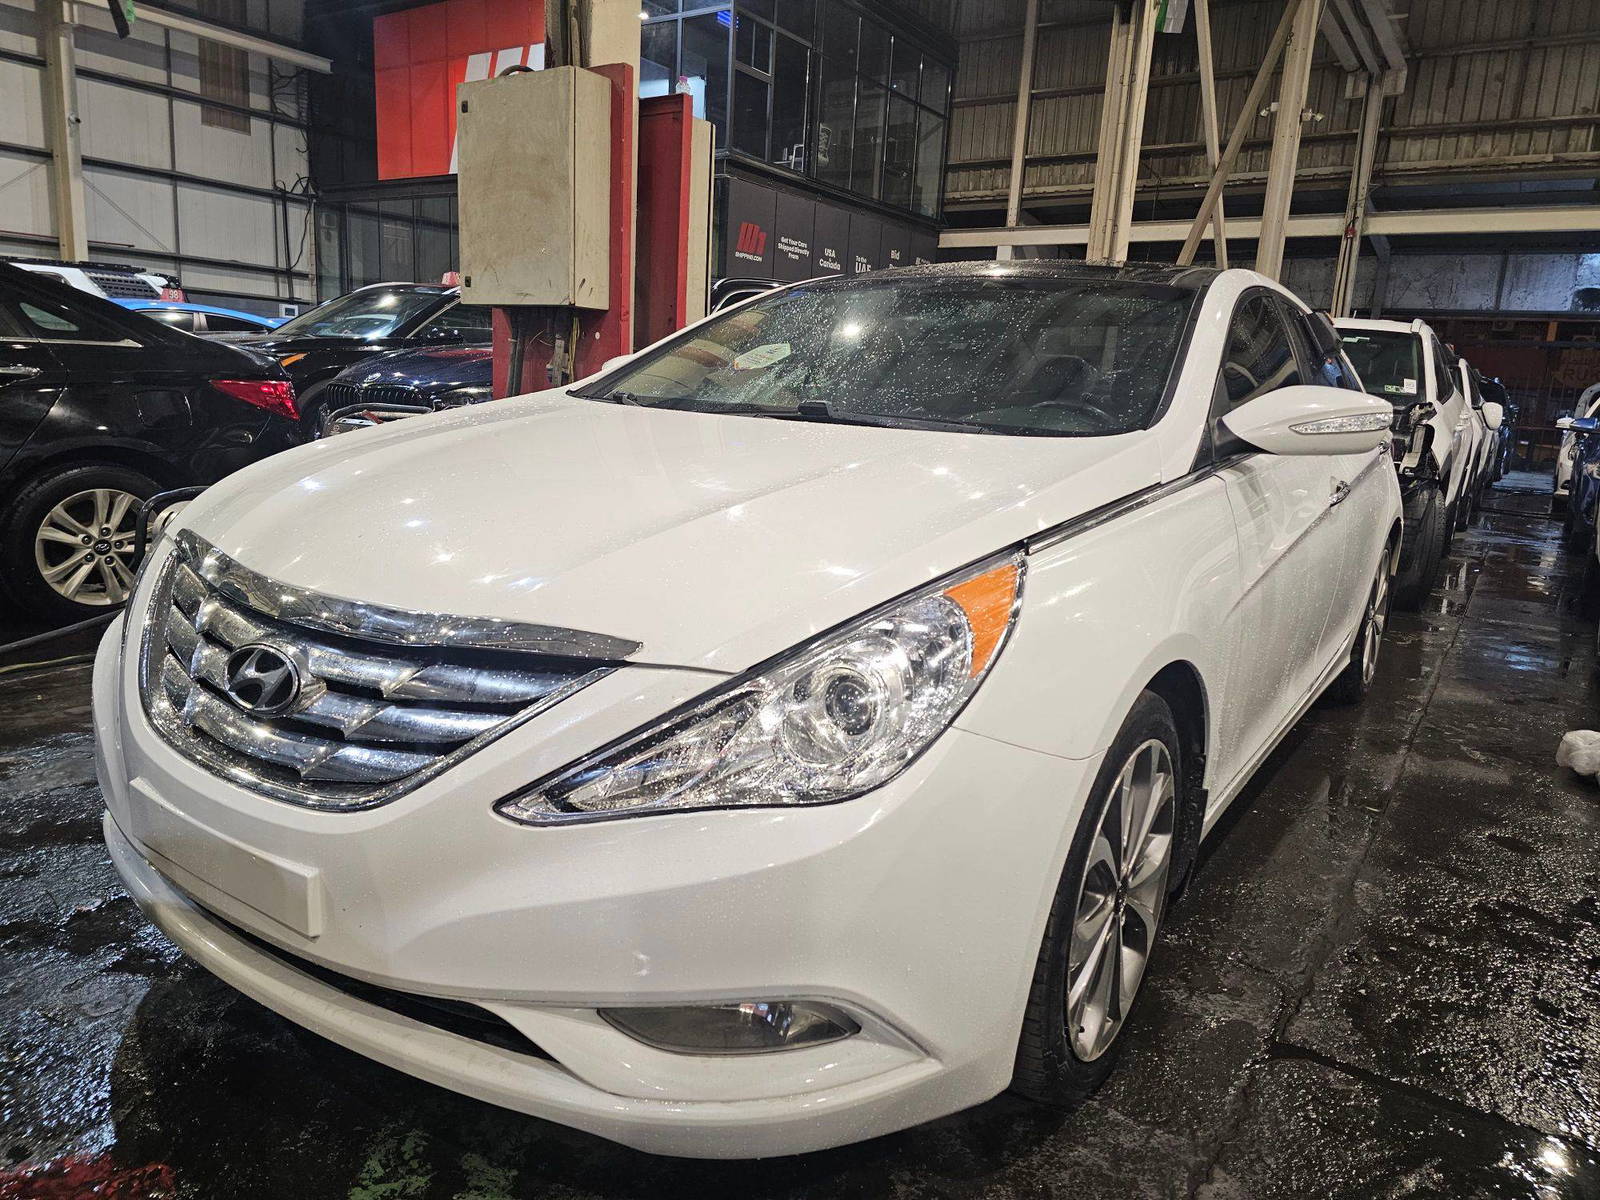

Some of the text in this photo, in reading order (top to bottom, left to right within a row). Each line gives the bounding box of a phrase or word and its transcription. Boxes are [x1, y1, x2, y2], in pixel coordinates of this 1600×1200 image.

[781, 236, 807, 248] Get Your Cars
[778, 243, 795, 252] Shipped
[735, 251, 763, 262] SHIPPING.COM
[788, 252, 799, 260] From
[824, 248, 836, 258] USA
[819, 258, 841, 270] Canada
